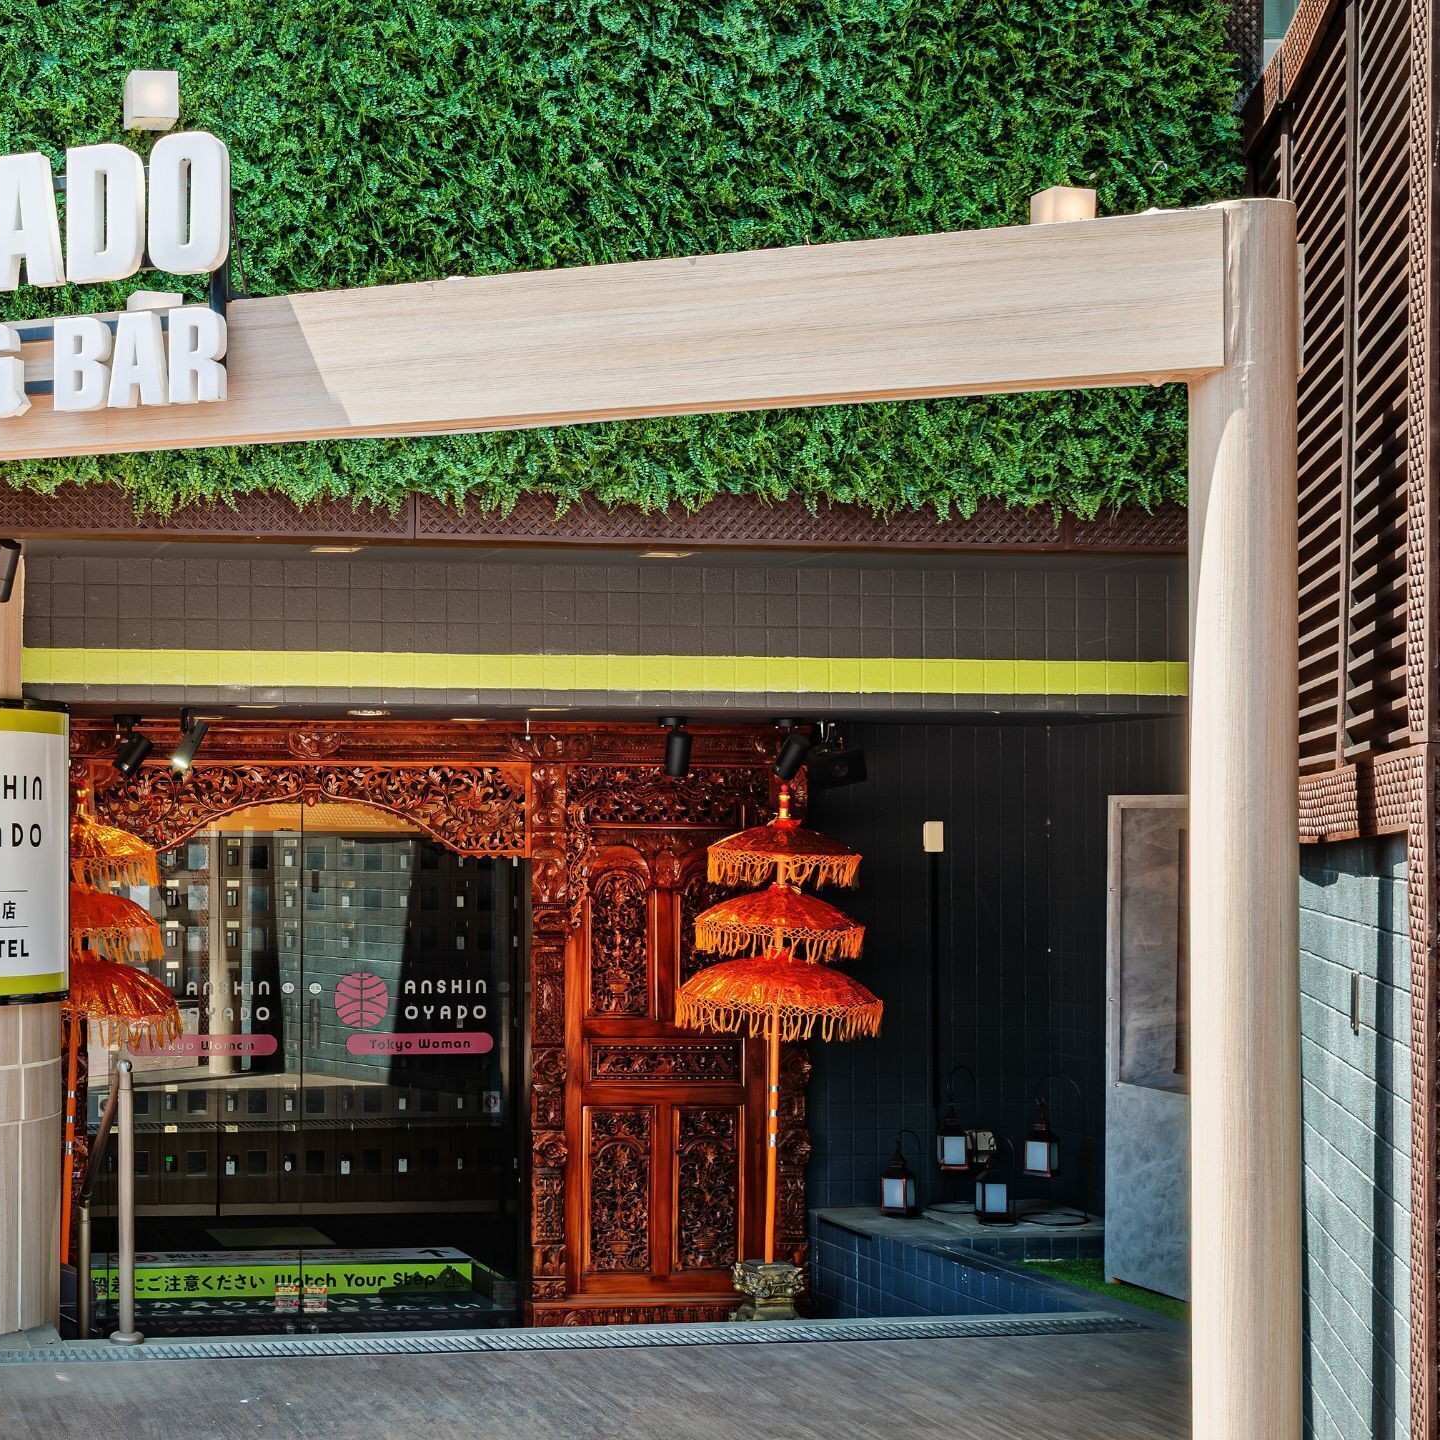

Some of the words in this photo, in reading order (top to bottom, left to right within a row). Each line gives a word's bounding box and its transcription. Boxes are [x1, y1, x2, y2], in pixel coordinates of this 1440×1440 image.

[52, 304, 227, 411] BAR
[186, 981, 270, 996] ANSHIN
[404, 979, 487, 994] ANSHIN
[405, 1005, 487, 1020] OYADO
[370, 1039, 412, 1053] Tokyo
[418, 1038, 471, 1049] Woman
[343, 1272, 386, 1288] Your
[392, 1271, 436, 1290] Step
